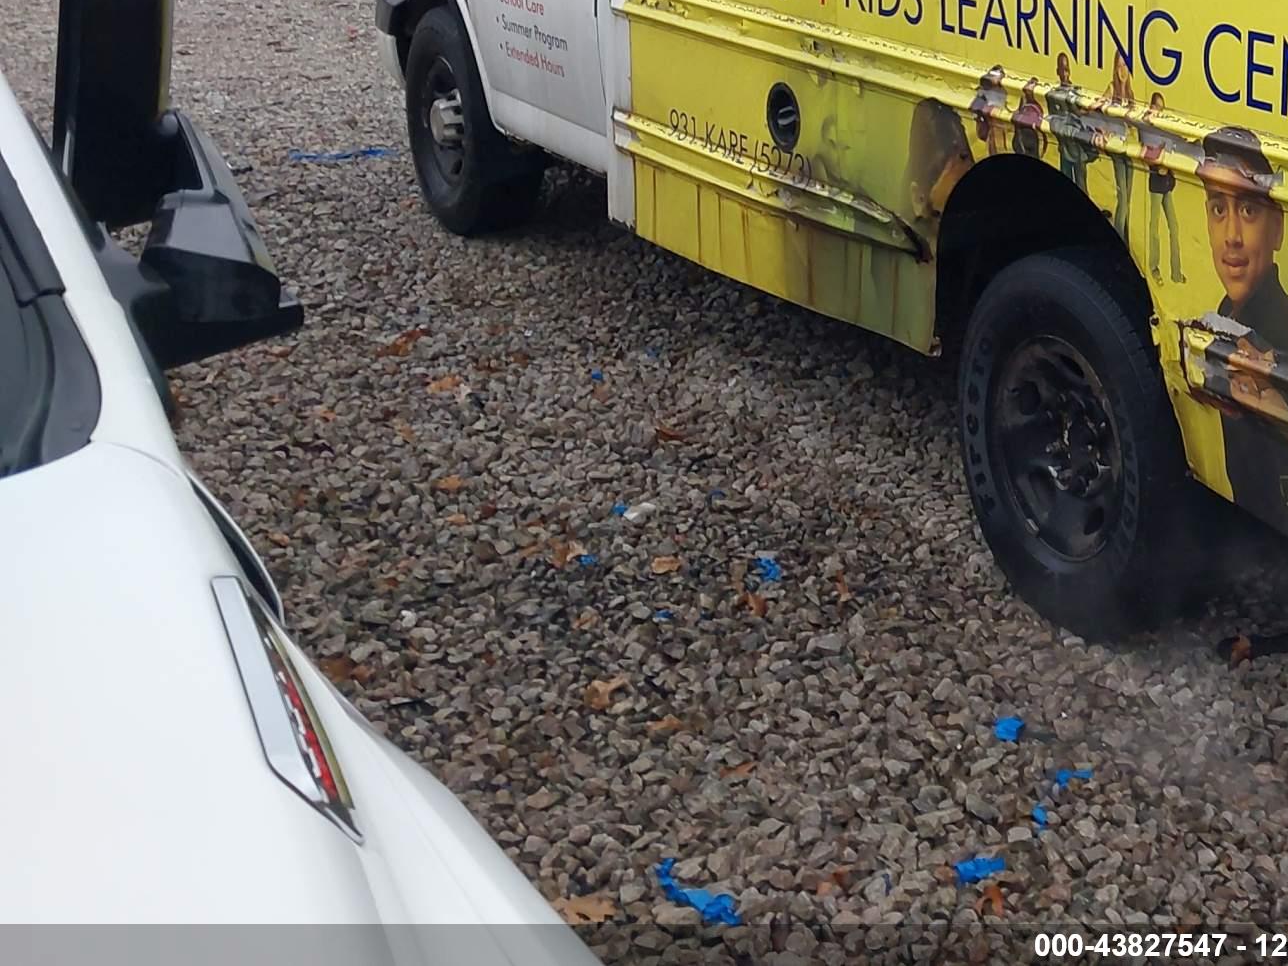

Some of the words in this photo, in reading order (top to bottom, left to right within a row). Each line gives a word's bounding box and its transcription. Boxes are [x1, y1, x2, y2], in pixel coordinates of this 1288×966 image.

[501, 14, 533, 39] Summer
[534, 25, 568, 52] Program
[505, 41, 540, 68] Extended
[540, 54, 566, 78] Hours
